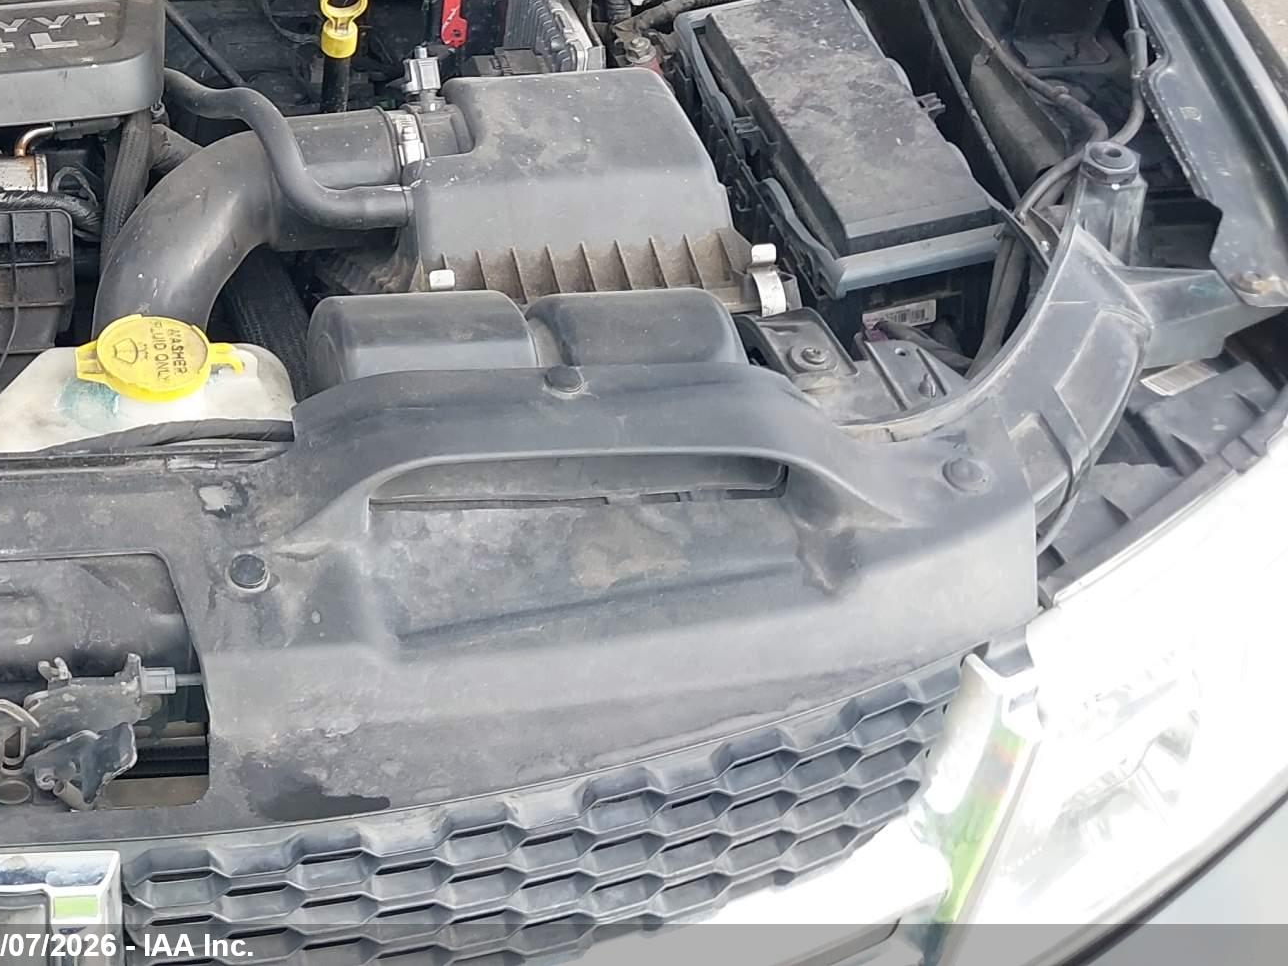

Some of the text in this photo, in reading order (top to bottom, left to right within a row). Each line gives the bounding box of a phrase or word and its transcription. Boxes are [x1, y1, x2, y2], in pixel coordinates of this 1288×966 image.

[149, 321, 172, 383] FLUID ONLY
[167, 328, 188, 376] WASHER
